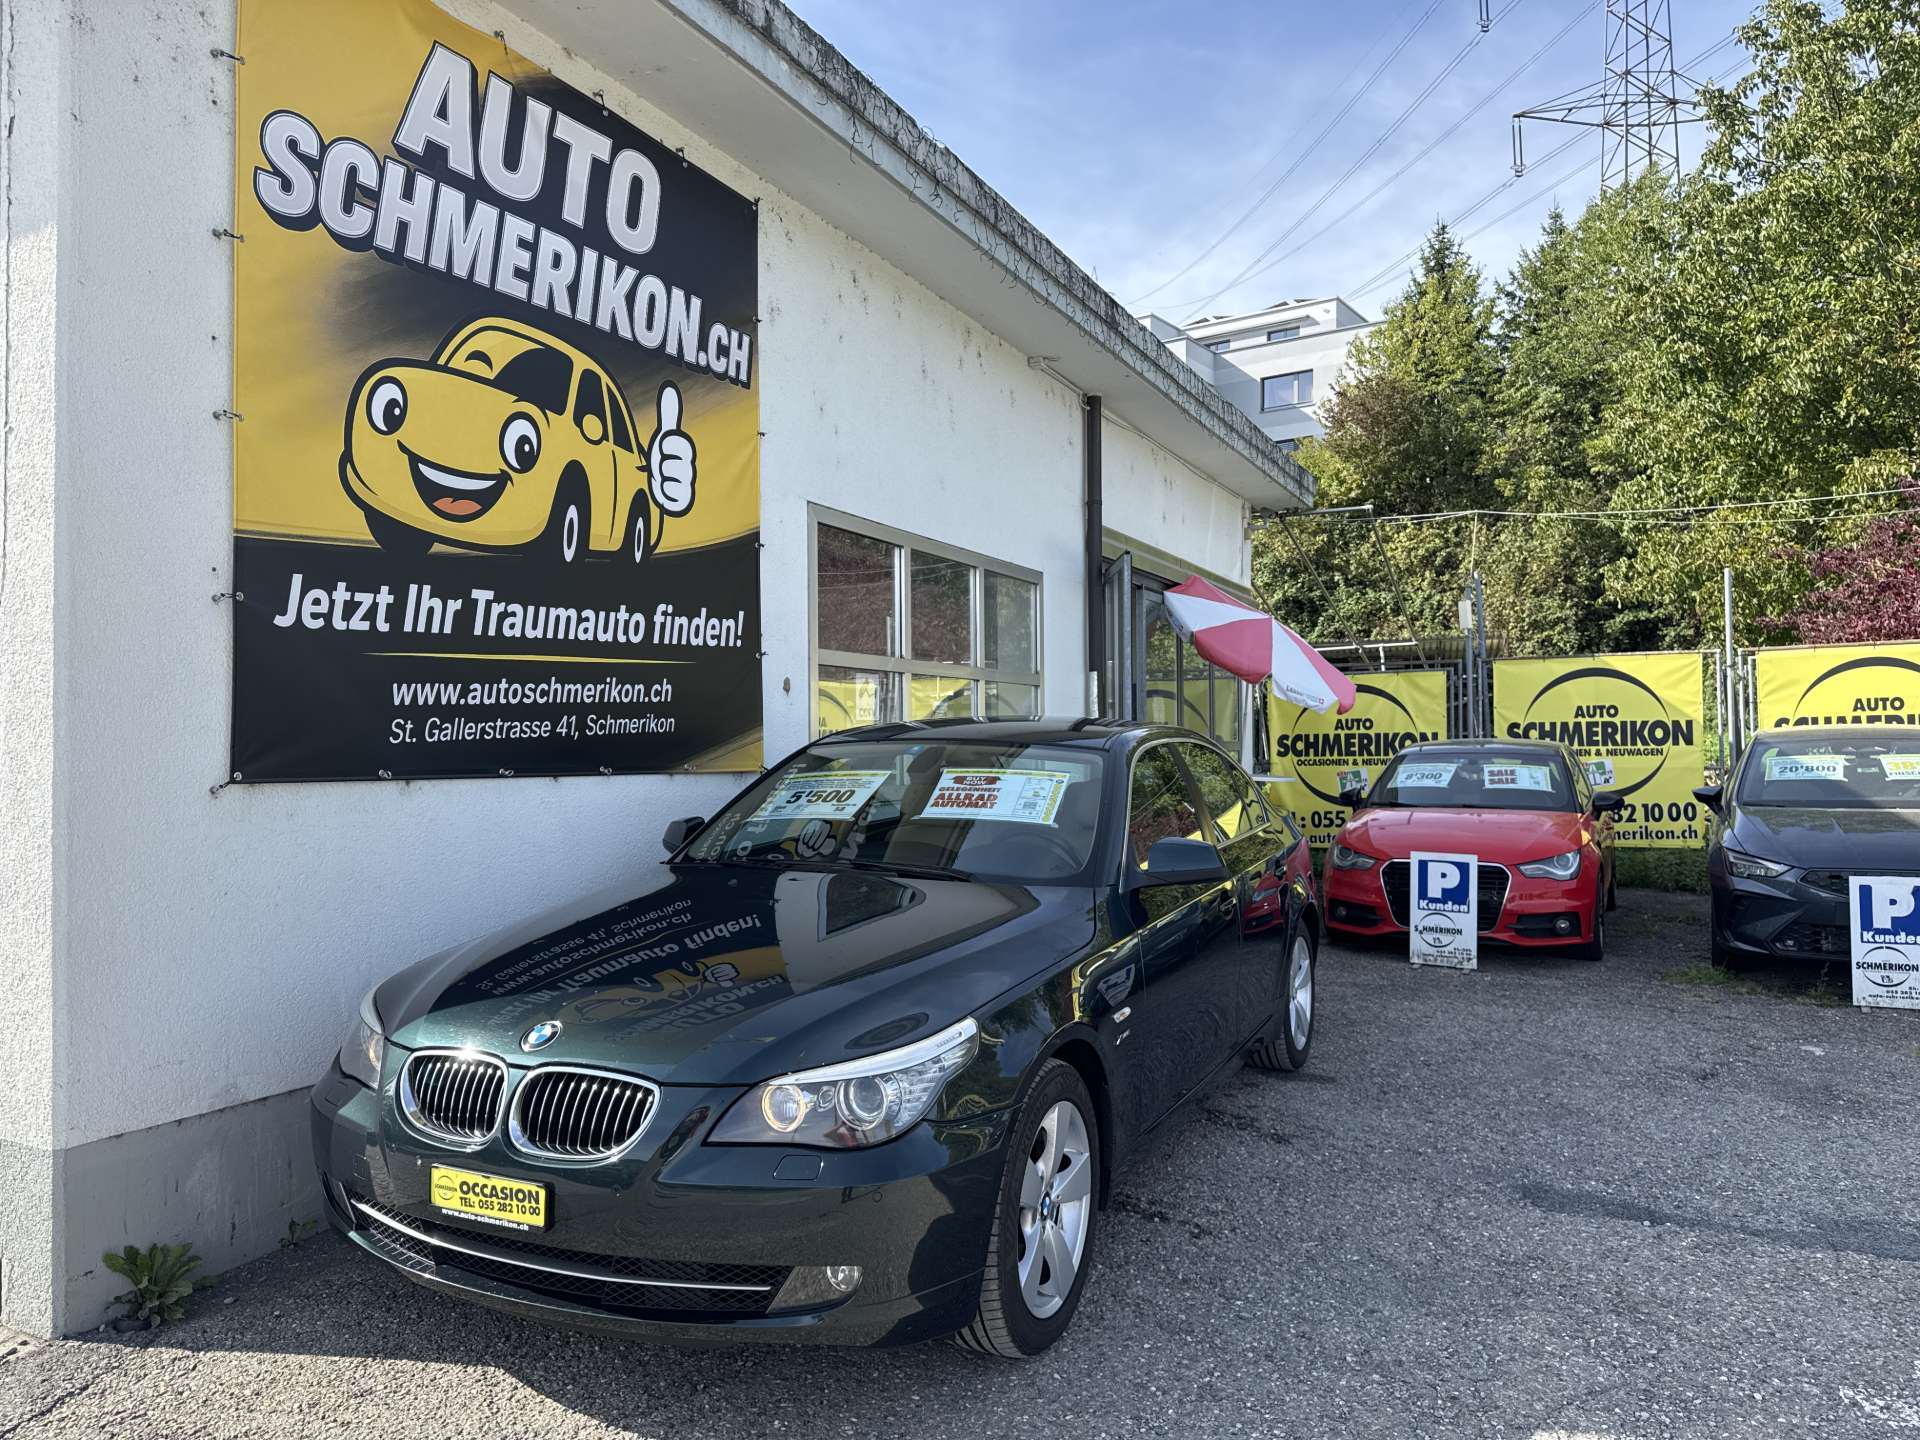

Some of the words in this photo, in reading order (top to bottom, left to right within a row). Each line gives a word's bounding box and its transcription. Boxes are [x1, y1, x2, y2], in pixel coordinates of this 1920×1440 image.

[395, 42, 661, 254] AUTO
[255, 111, 752, 384] SCHMERIKON.CH
[272, 573, 394, 633] Jetzt
[403, 583, 462, 635] Ihr
[470, 589, 646, 645] Traumauto
[653, 603, 744, 648] finden!
[392, 676, 672, 706] www.autoschmerikon.ch
[1574, 704, 1619, 718] AUTO
[1853, 697, 1905, 712] AUTO
[389, 718, 417, 744] St.
[424, 715, 551, 742] Gallerstrasse
[556, 715, 580, 741] 41,
[585, 714, 675, 736] Schmerikon
[1334, 718, 1374, 731] AUTO
[1507, 719, 1694, 747] SCHMERIKON
[1595, 748, 1602, 756] &
[1606, 748, 1663, 756] NEUWAGEN
[1296, 758, 1349, 766] OCCASIONEN
[1352, 758, 1359, 766] &
[1362, 758, 1391, 766] NEUW
[1487, 769, 1518, 777] SALE
[1488, 777, 1518, 785] SALE
[786, 789, 856, 804] 5'500
[931, 800, 998, 809] AUTOMAT
[934, 793, 998, 801] ALLRAD
[1311, 811, 1346, 828] 055
[1641, 802, 1664, 822] 10
[1668, 802, 1697, 822] 00
[1427, 861, 1461, 898] P
[1419, 899, 1468, 912] Kunden
[1871, 885, 1915, 929] P
[1856, 961, 1919, 972] SCHMERIKON
[459, 1180, 540, 1205] OCCASION
[459, 1197, 475, 1208] TEL:
[478, 1199, 495, 1211] 055
[497, 1202, 513, 1213] 282
[516, 1204, 527, 1214] 10
[529, 1206, 540, 1216] 00
